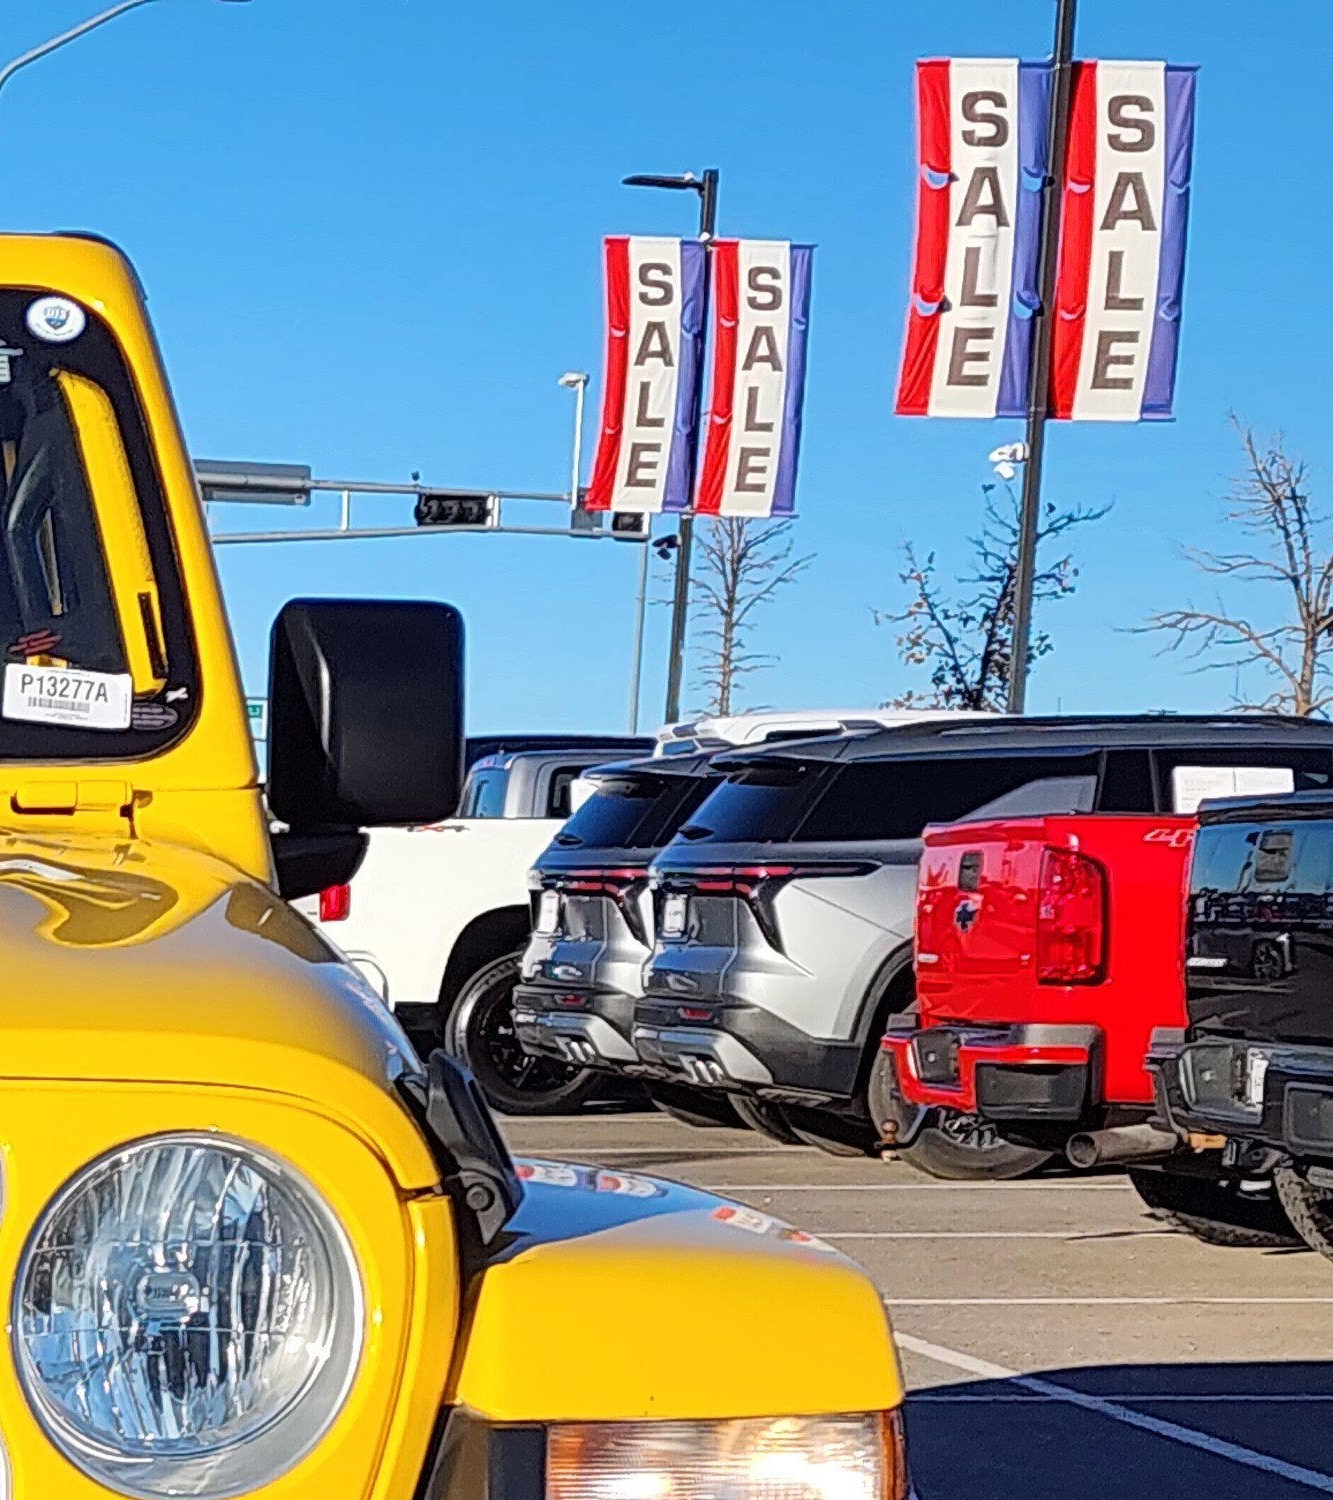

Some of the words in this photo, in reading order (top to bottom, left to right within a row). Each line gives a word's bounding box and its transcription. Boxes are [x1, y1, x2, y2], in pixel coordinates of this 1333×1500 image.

[946, 89, 1011, 388] SALE
[1090, 93, 1158, 392] SALE
[623, 262, 674, 489] SALE
[733, 265, 783, 494] SALE
[20, 673, 109, 703] P13277A
